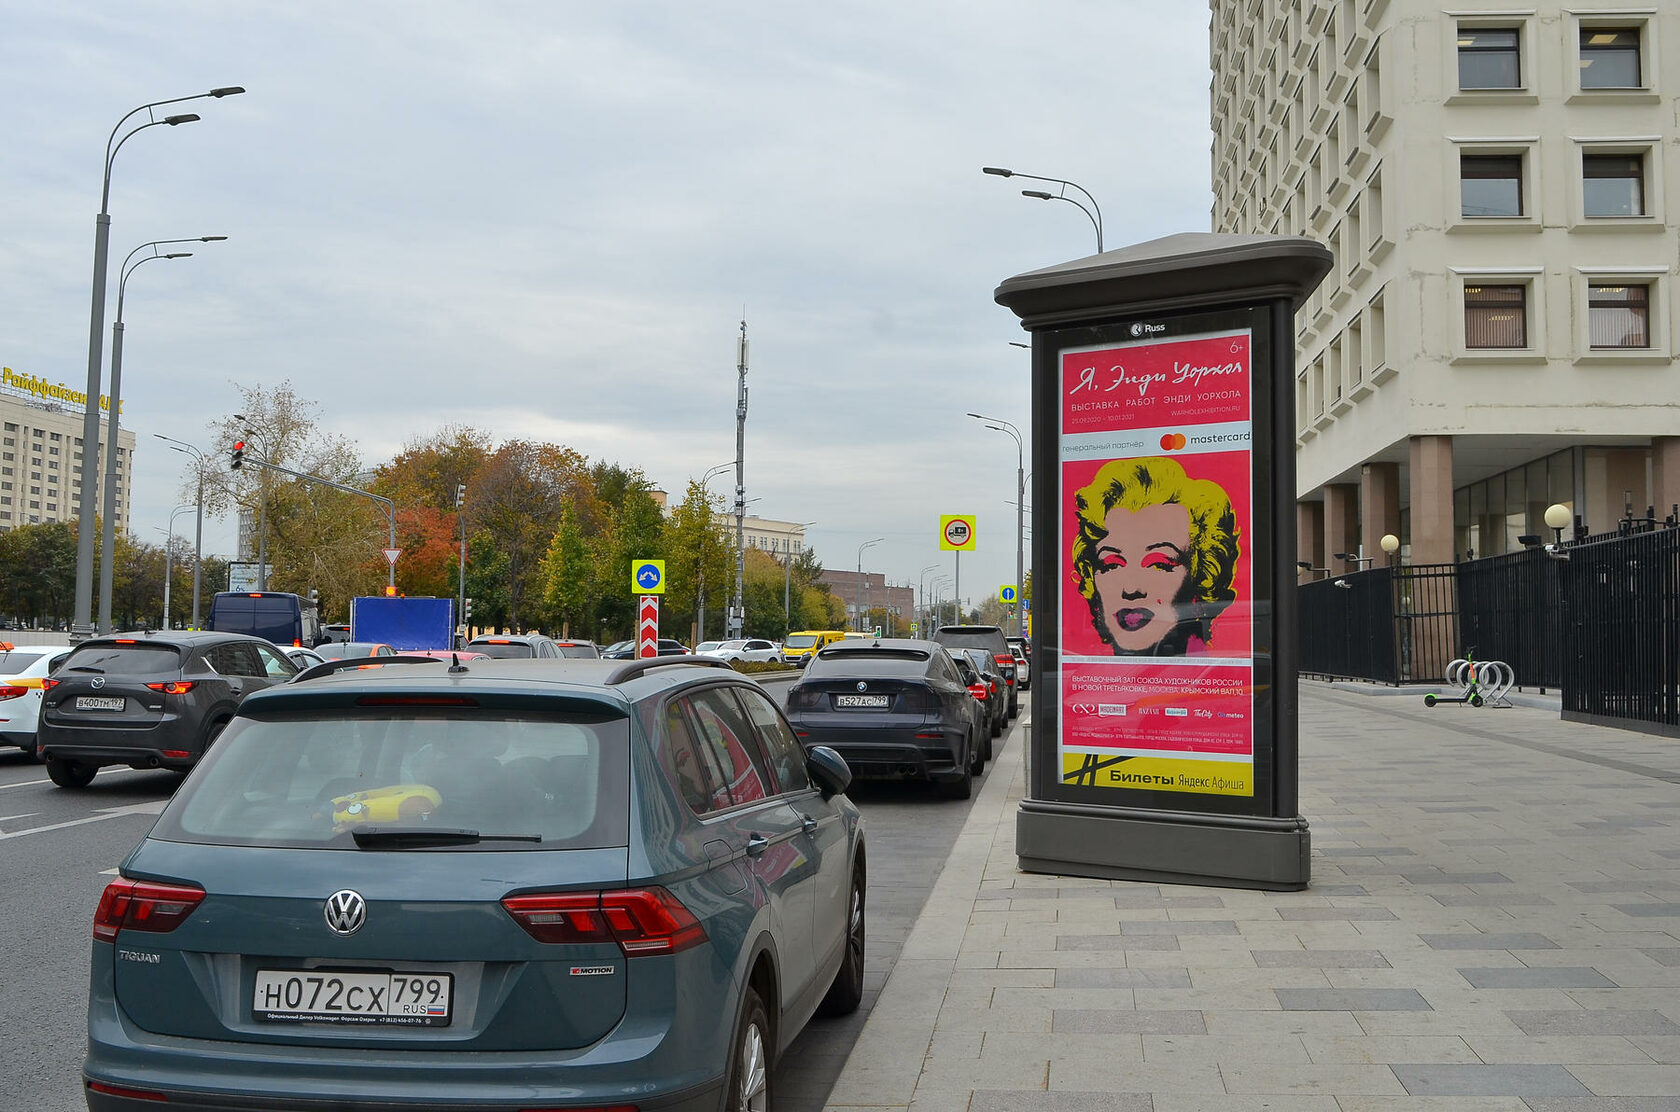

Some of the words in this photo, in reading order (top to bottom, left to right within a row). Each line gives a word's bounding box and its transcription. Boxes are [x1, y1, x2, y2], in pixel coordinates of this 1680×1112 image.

[1144, 324, 1166, 332] Russ
[1230, 341, 1244, 354] 6+
[1069, 367, 1099, 395] Я,
[1104, 365, 1166, 396] Энди
[1172, 361, 1243, 387] Уорхол
[3, 366, 87, 406] Райффайзен
[1071, 401, 1119, 412] ВЫСТАВКА
[1125, 397, 1156, 407] РАБОТ
[1163, 394, 1191, 404] ЭНДИ
[1197, 390, 1242, 401] УОРХОЛА
[1190, 432, 1251, 445] mastercard
[1062, 442, 1111, 452] генеральный
[1072, 674, 1122, 684] ВЫСТАВОЧНЫЙ
[1136, 677, 1163, 685] СОЮЗА
[1165, 677, 1212, 686] ХУДОЖНИКОВ
[1212, 679, 1243, 687] РОССИИ
[1078, 683, 1102, 691] НОВОЙ
[1181, 686, 1220, 695] КРЫМСКИЙ
[872, 696, 887, 704] 799
[1110, 770, 1174, 785] Билеты
[1178, 774, 1210, 788] Яндекс
[1211, 776, 1244, 790] Афиша
[119, 950, 160, 963] TIGUAN
[393, 978, 441, 1004] 799
[403, 1005, 427, 1014] RUS
